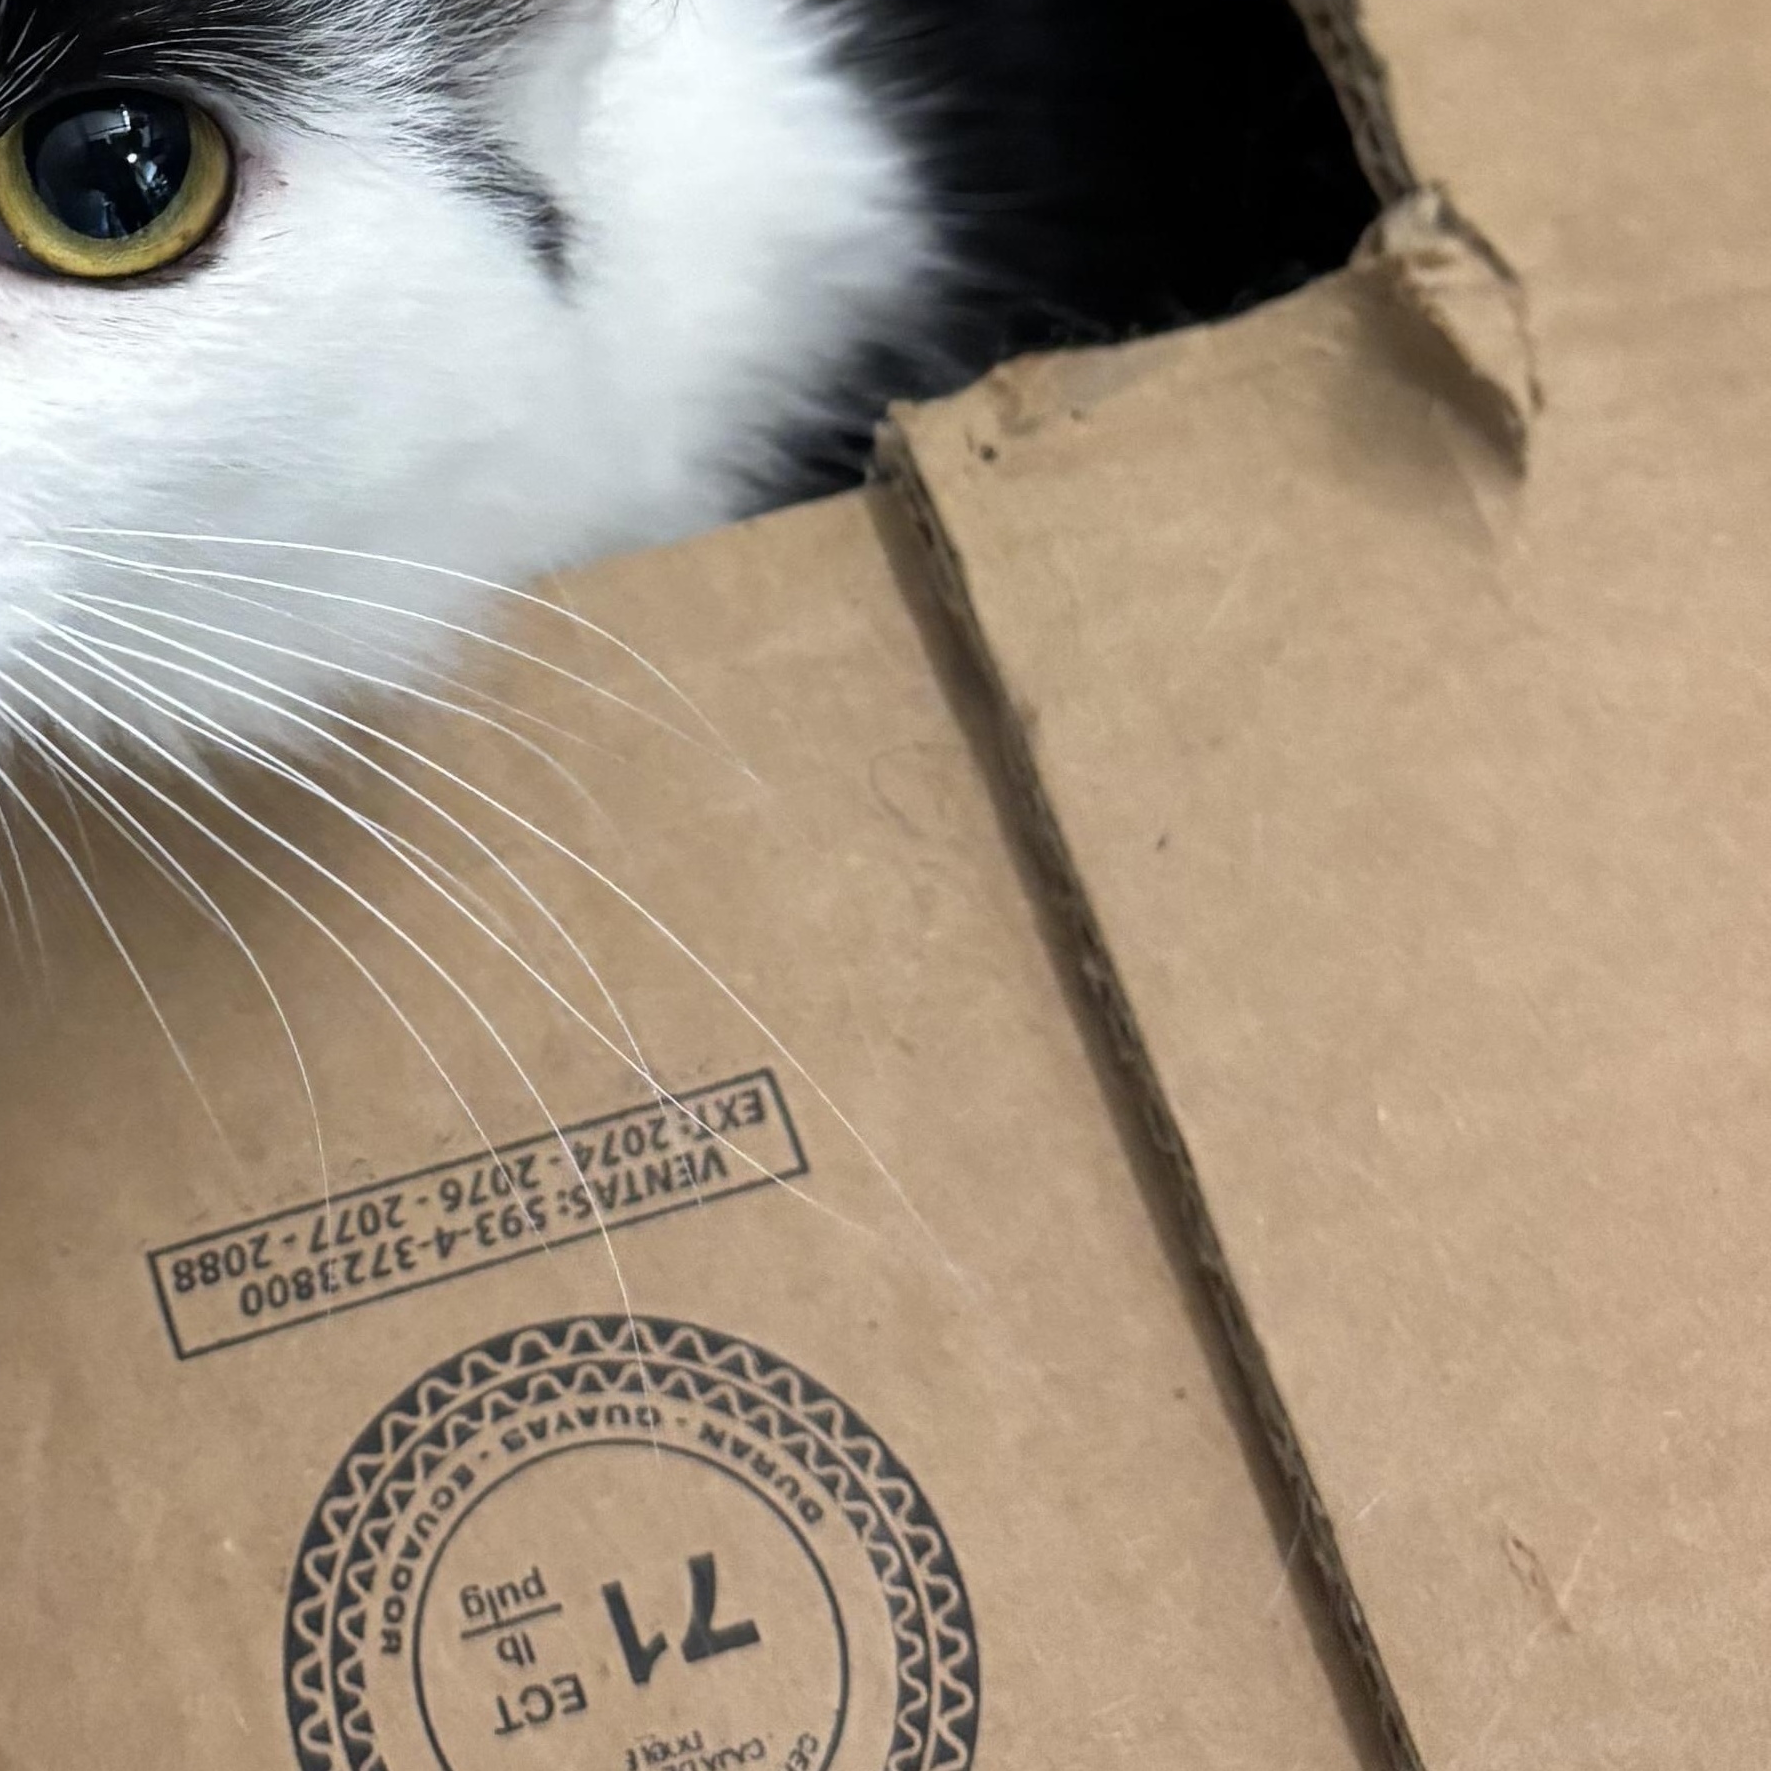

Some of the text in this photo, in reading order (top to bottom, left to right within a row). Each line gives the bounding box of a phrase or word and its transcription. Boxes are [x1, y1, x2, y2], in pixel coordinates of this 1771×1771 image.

[677, 1087, 767, 1139] EXT:
[570, 1117, 669, 1166] 2074
[438, 1153, 537, 1207] 2076
[238, 1144, 729, 1319] VENTAS: 593-4-3723800
[309, 1193, 402, 1240] 2077
[170, 1234, 272, 1293] 2088
[499, 1405, 661, 1457] GUAYAS
[696, 1420, 825, 1525] DURAN
[381, 1466, 478, 1656] ECUADOR
[459, 1566, 546, 1621] pulg
[601, 1551, 761, 1684] 71
[498, 1630, 535, 1667] lb
[493, 1673, 588, 1736] ECT
